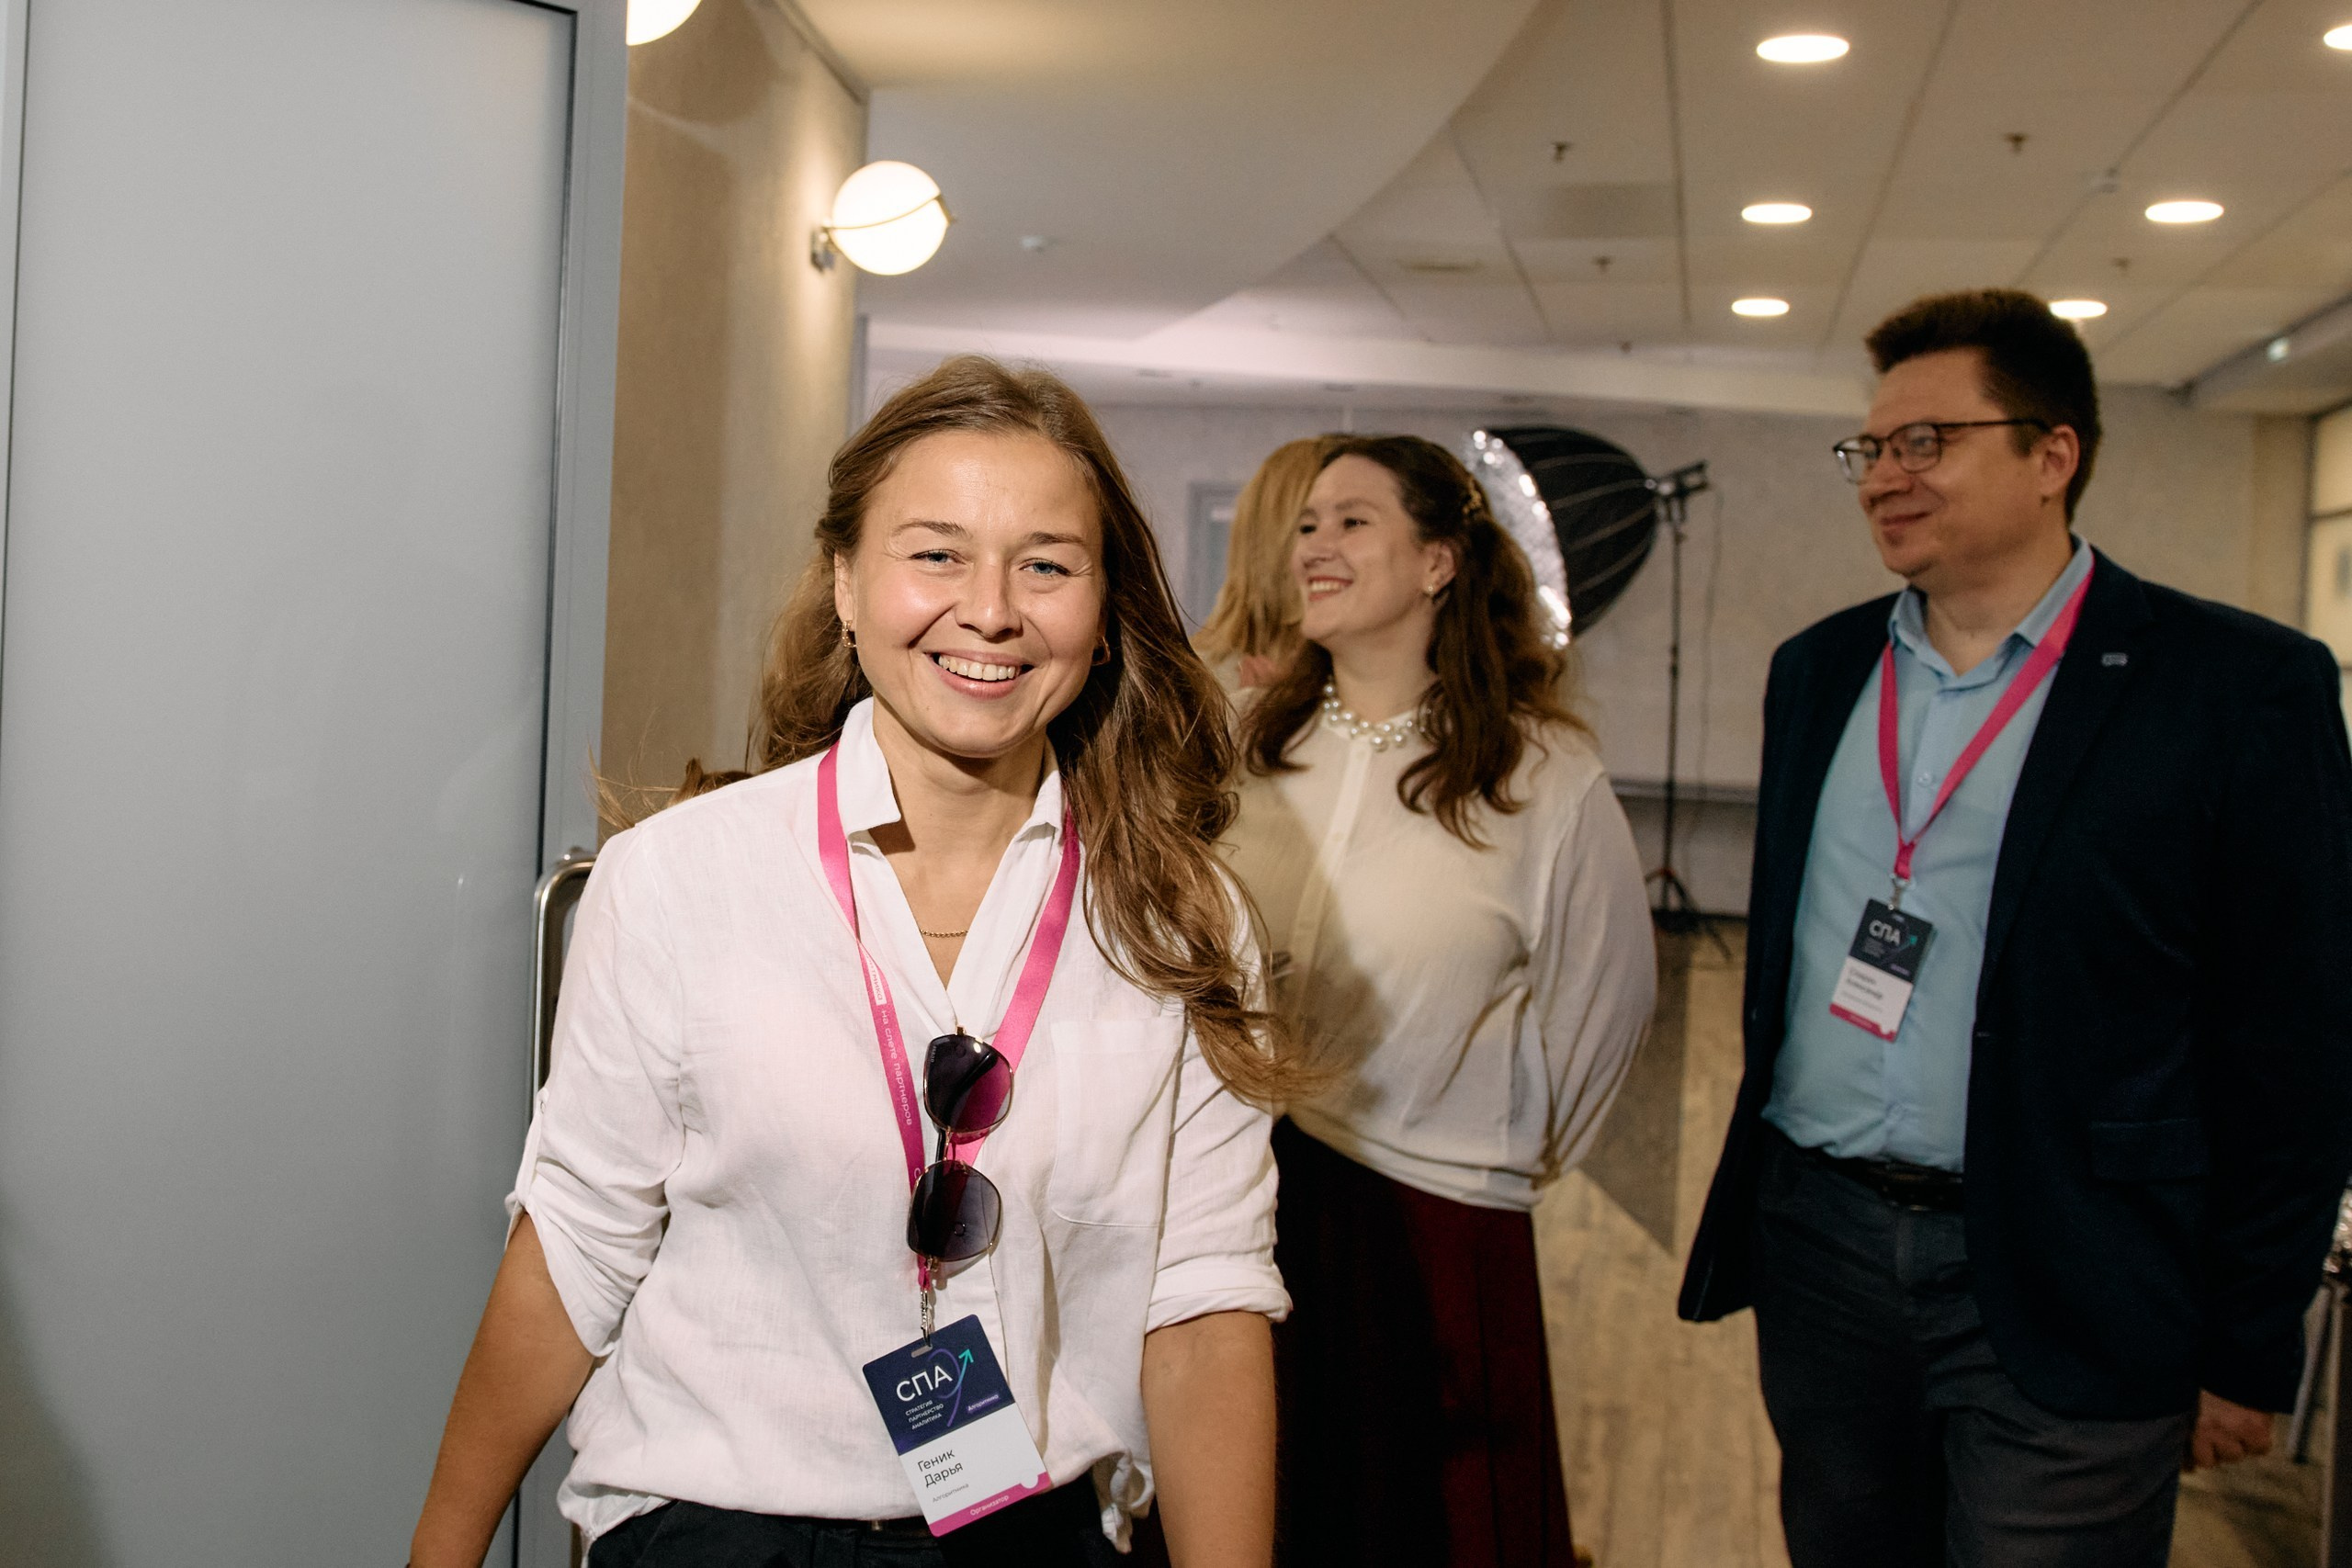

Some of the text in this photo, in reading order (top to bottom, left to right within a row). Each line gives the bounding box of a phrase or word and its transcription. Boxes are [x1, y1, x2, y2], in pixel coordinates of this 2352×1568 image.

[881, 1010, 888, 1025] на
[885, 1029, 898, 1059] слете
[894, 1062, 912, 1126] партнеров
[896, 1365, 953, 1402] СПА
[905, 1399, 933, 1416] СТРАТЕГИЯ
[908, 1403, 944, 1423] ПАРТНЕРСТВО
[911, 1412, 943, 1430] АНАЛИТИКА
[917, 1449, 956, 1472] Геник
[924, 1462, 964, 1488] Дарья
[969, 1494, 1010, 1516] Организатор
